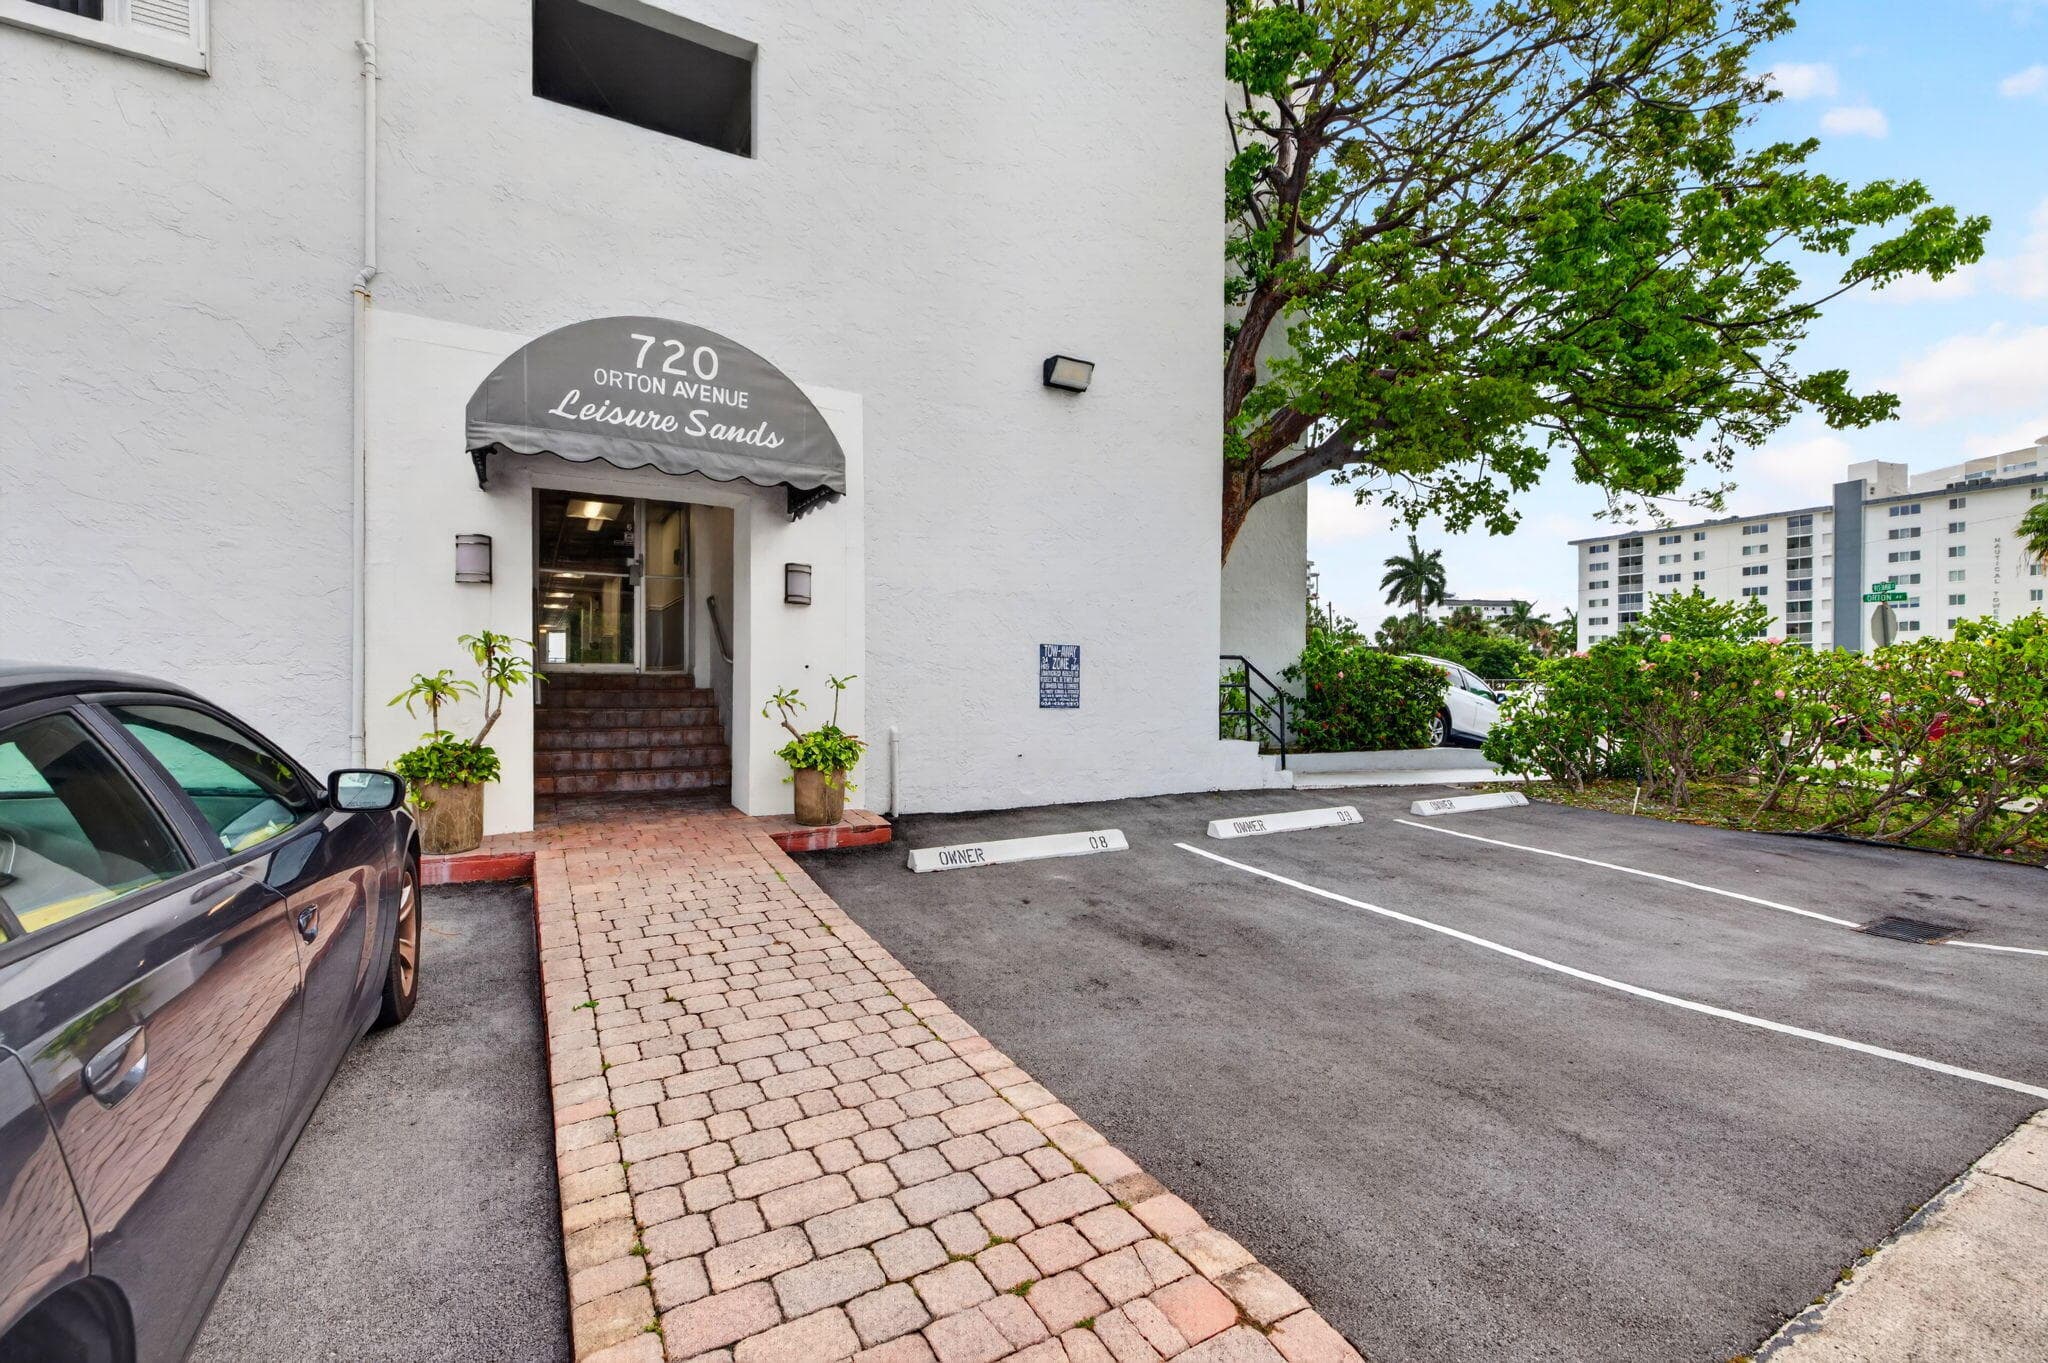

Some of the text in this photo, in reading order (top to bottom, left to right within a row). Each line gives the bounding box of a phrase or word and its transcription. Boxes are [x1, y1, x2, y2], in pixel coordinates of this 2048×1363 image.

[630, 333, 719, 381] 720
[593, 368, 749, 409] ORTON AVENUE
[548, 389, 785, 449] Leisure Sands
[1044, 645, 1077, 657] TOW-AWAY
[1052, 657, 1070, 670] ZONE
[1429, 799, 1456, 811] OWNER
[1233, 811, 1353, 834] OWNER 09
[939, 835, 1109, 866] OWNER 08
